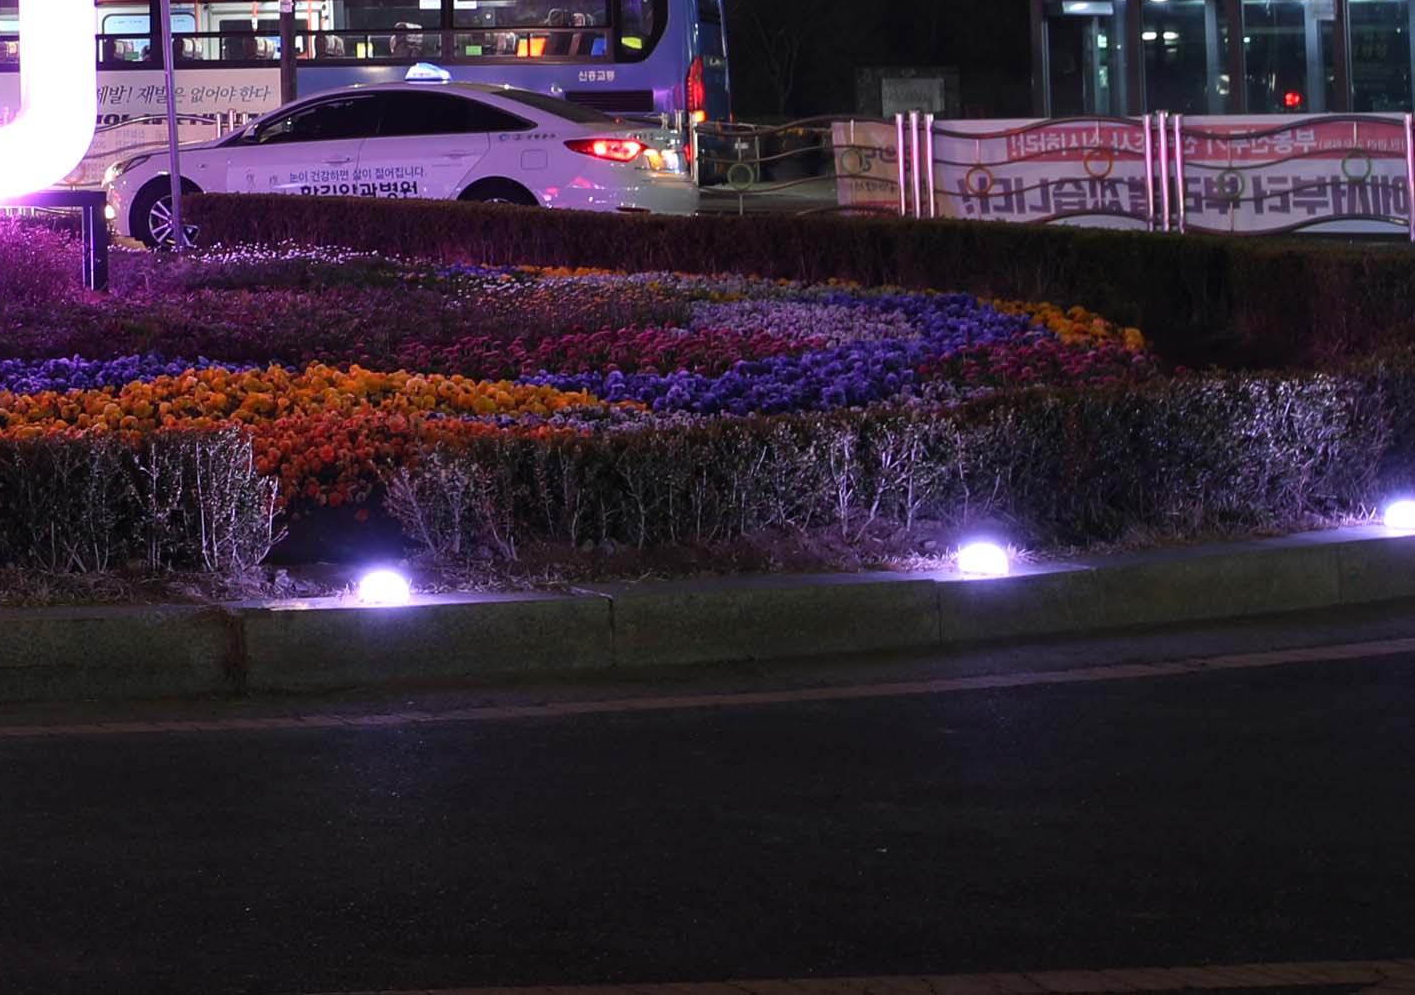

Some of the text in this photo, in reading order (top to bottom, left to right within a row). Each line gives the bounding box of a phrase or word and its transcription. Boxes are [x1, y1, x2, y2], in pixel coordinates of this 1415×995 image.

[190, 86, 238, 103] 없어야
[240, 85, 272, 103] 한다
[289, 172, 308, 183] 눈이
[310, 170, 349, 182] 건강하면
